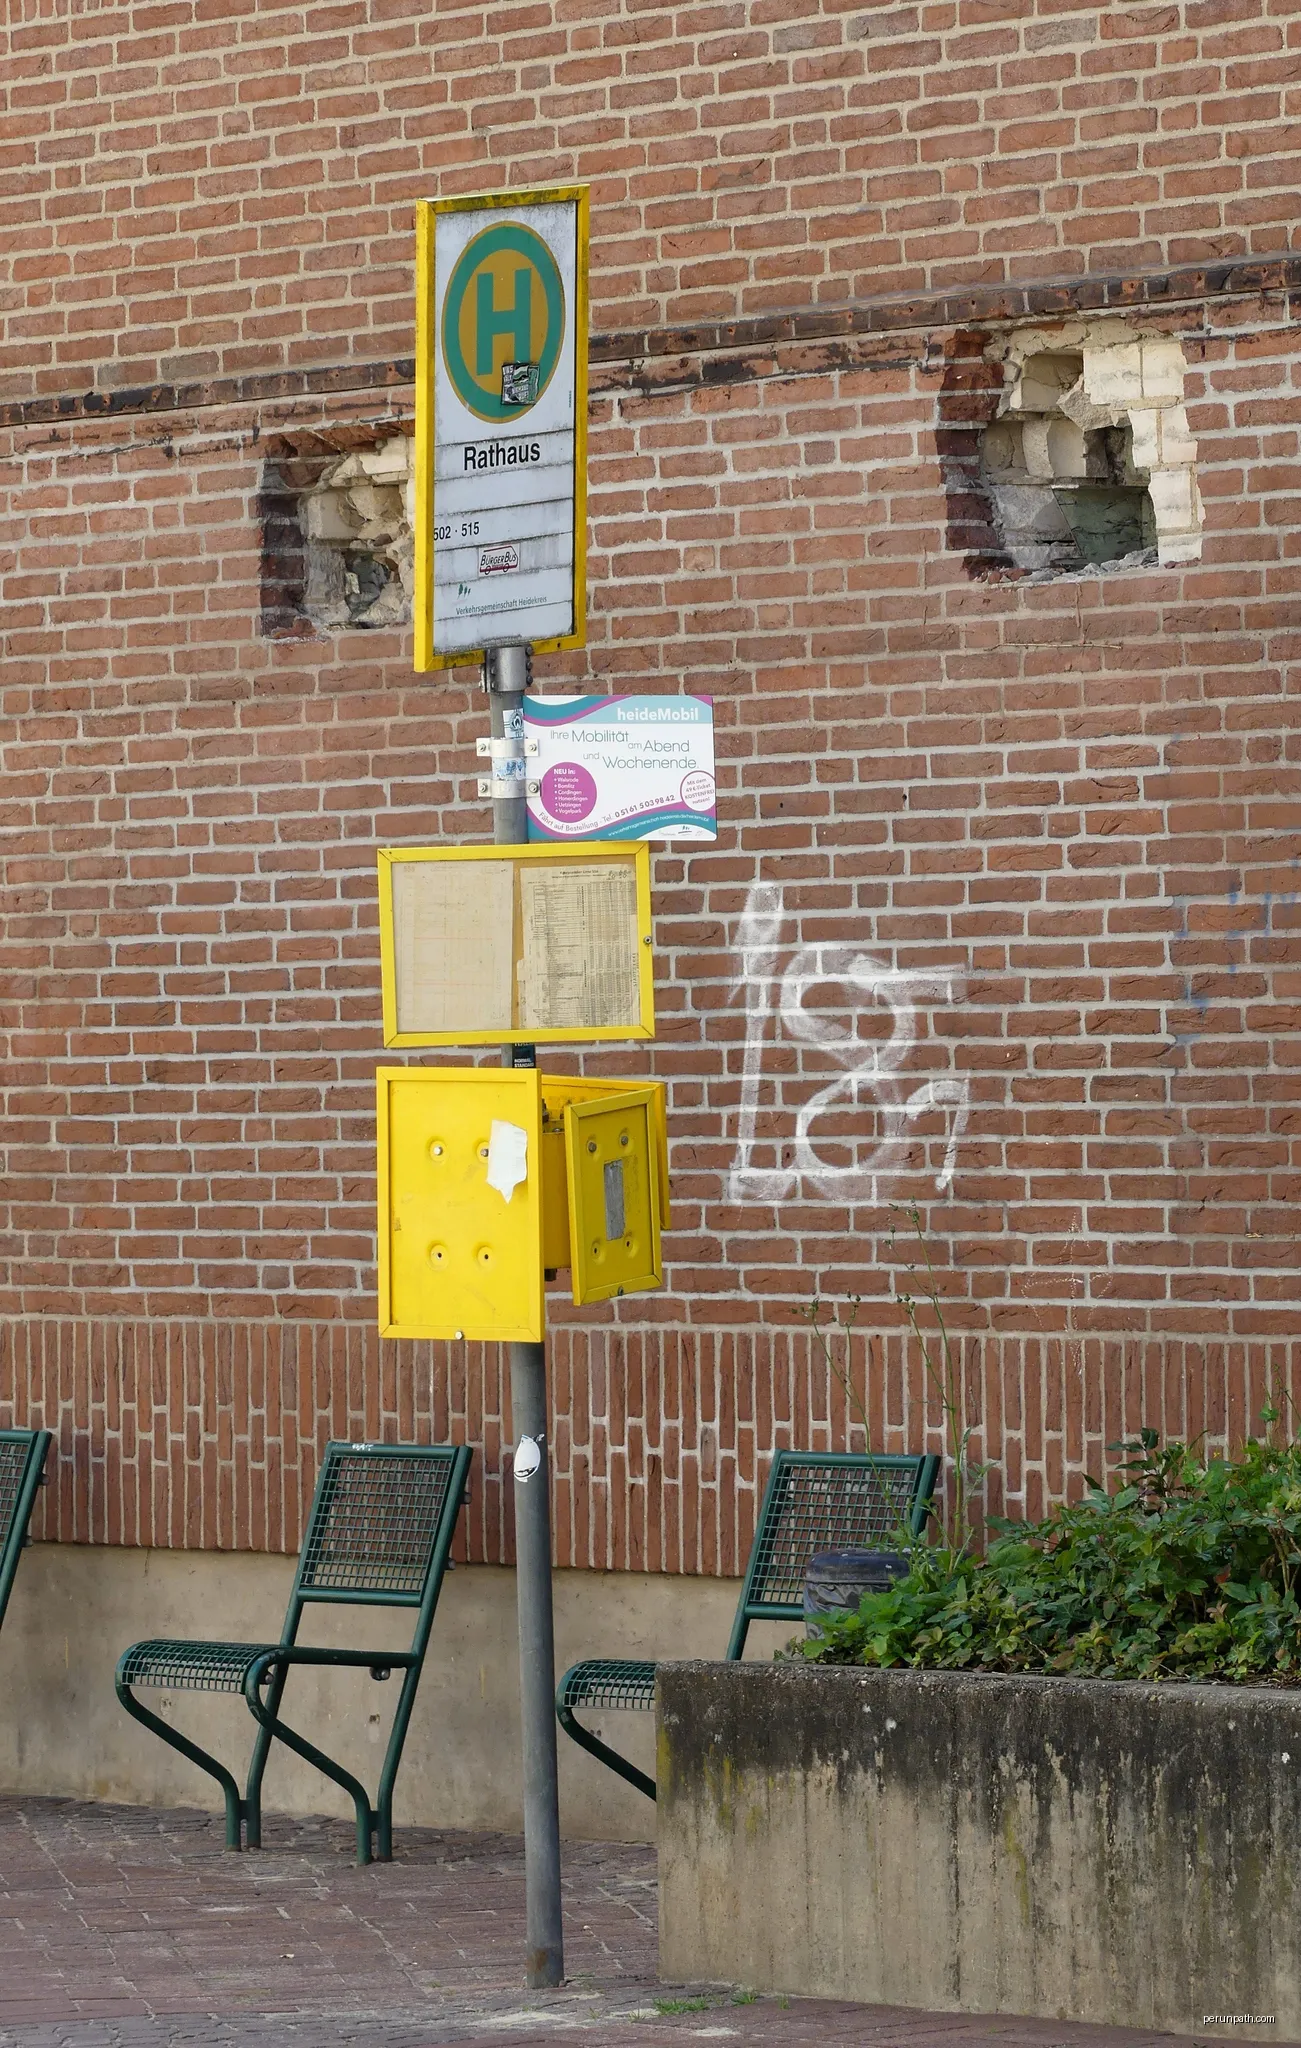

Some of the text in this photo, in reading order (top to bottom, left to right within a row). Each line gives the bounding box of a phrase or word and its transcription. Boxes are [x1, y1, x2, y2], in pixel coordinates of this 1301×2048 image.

[477, 268, 531, 376] H
[464, 443, 541, 471] Rathaus
[433, 522, 480, 541] 502 515
[456, 595, 547, 615] Verkehrsgemeinschaft Heidekreis
[617, 708, 699, 721] heideMobil
[550, 730, 629, 743] Ihre Mobilität
[583, 751, 600, 760] und
[643, 740, 690, 753] Abend
[539, 811, 554, 826] Fährt
[554, 823, 564, 831] auf
[565, 821, 599, 832] Bestellung
